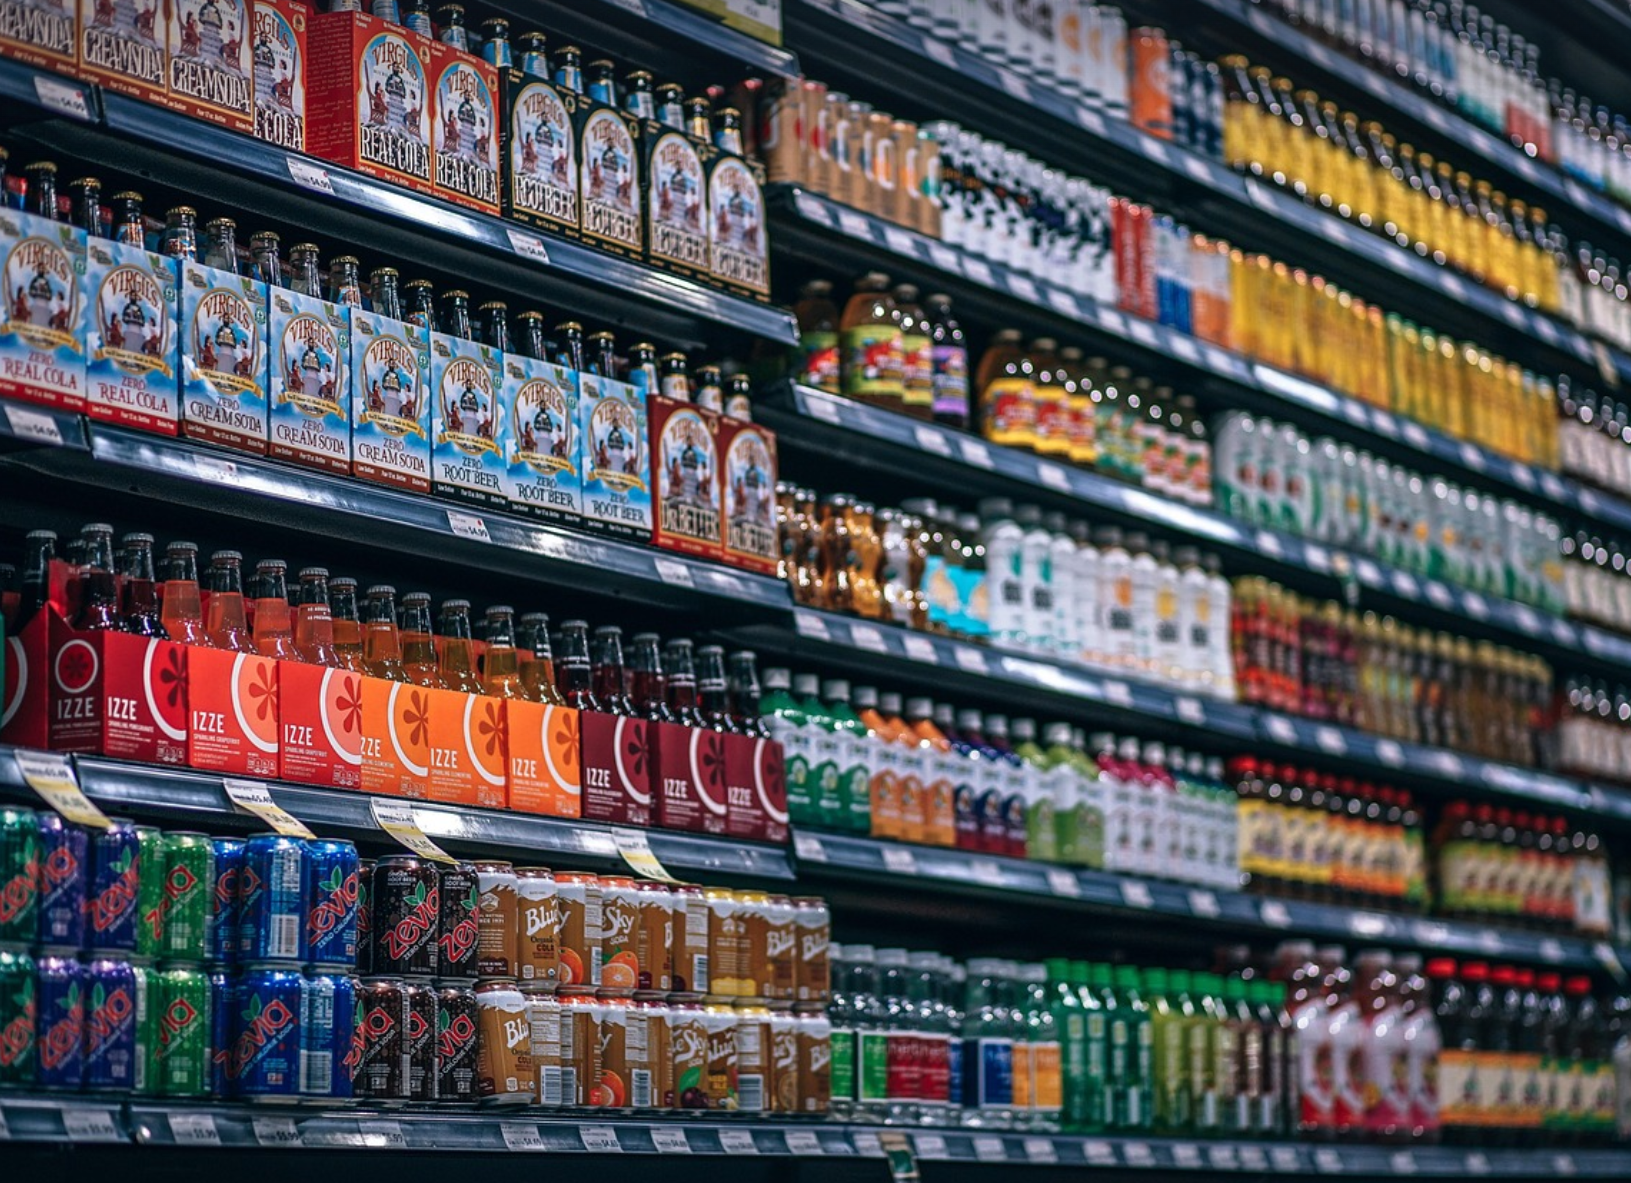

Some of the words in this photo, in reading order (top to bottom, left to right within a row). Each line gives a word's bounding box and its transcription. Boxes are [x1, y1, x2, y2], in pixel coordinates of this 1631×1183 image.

[254, 10, 290, 51] RGIL'S
[371, 41, 417, 81] VIRGIL'S
[446, 70, 486, 109] VIRGIL'S
[523, 92, 564, 130] VIRGIL'S
[260, 110, 303, 150] COLA
[360, 126, 396, 167] REAL
[397, 138, 430, 179] COLA
[435, 151, 468, 192] REAL
[470, 164, 498, 204] COLA
[16, 242, 69, 283] VIRGIL'S
[108, 269, 160, 309] VIRGIL'S
[203, 292, 251, 332] VIRGIL'S
[289, 317, 334, 356] VIRGIL'S
[3, 357, 42, 379] REAL
[44, 367, 77, 389] COLA
[29, 351, 54, 366] ZERO
[370, 340, 414, 377] VIRGIL'S
[121, 375, 146, 390] ZERO
[448, 362, 489, 395] VIRGIL'S
[97, 382, 134, 404] REAL
[136, 391, 169, 413] COLA
[217, 396, 240, 410] ZERO
[521, 383, 563, 416] VIRGIL'S
[190, 400, 232, 425] CREAM
[234, 413, 262, 433] SODA
[302, 418, 324, 433] ZERO
[276, 424, 317, 447] CREAM
[318, 435, 345, 455] SODA
[383, 437, 405, 453] ZERO
[358, 442, 398, 465] CREAM
[399, 452, 425, 472] SODA
[462, 456, 482, 470] ZERO
[441, 463, 472, 482] ROOT
[472, 470, 502, 492] BEER
[536, 475, 557, 488] ZERO
[515, 483, 545, 501] ROOT
[546, 489, 576, 511] BEER
[591, 500, 620, 518] ROOT
[620, 504, 646, 525] BEER
[57, 696, 95, 720] IZZE
[107, 696, 138, 720] IZZE
[193, 710, 225, 733] IZZE
[284, 724, 313, 746] IZZE
[360, 736, 381, 758] ZZE
[431, 748, 458, 769] IZZE
[512, 757, 537, 778] IZZE
[587, 767, 610, 788] IZZE
[664, 778, 688, 799] IZZE
[728, 786, 752, 806] IZZE
[602, 906, 634, 938] Sky
[504, 1018, 530, 1049] Blu
